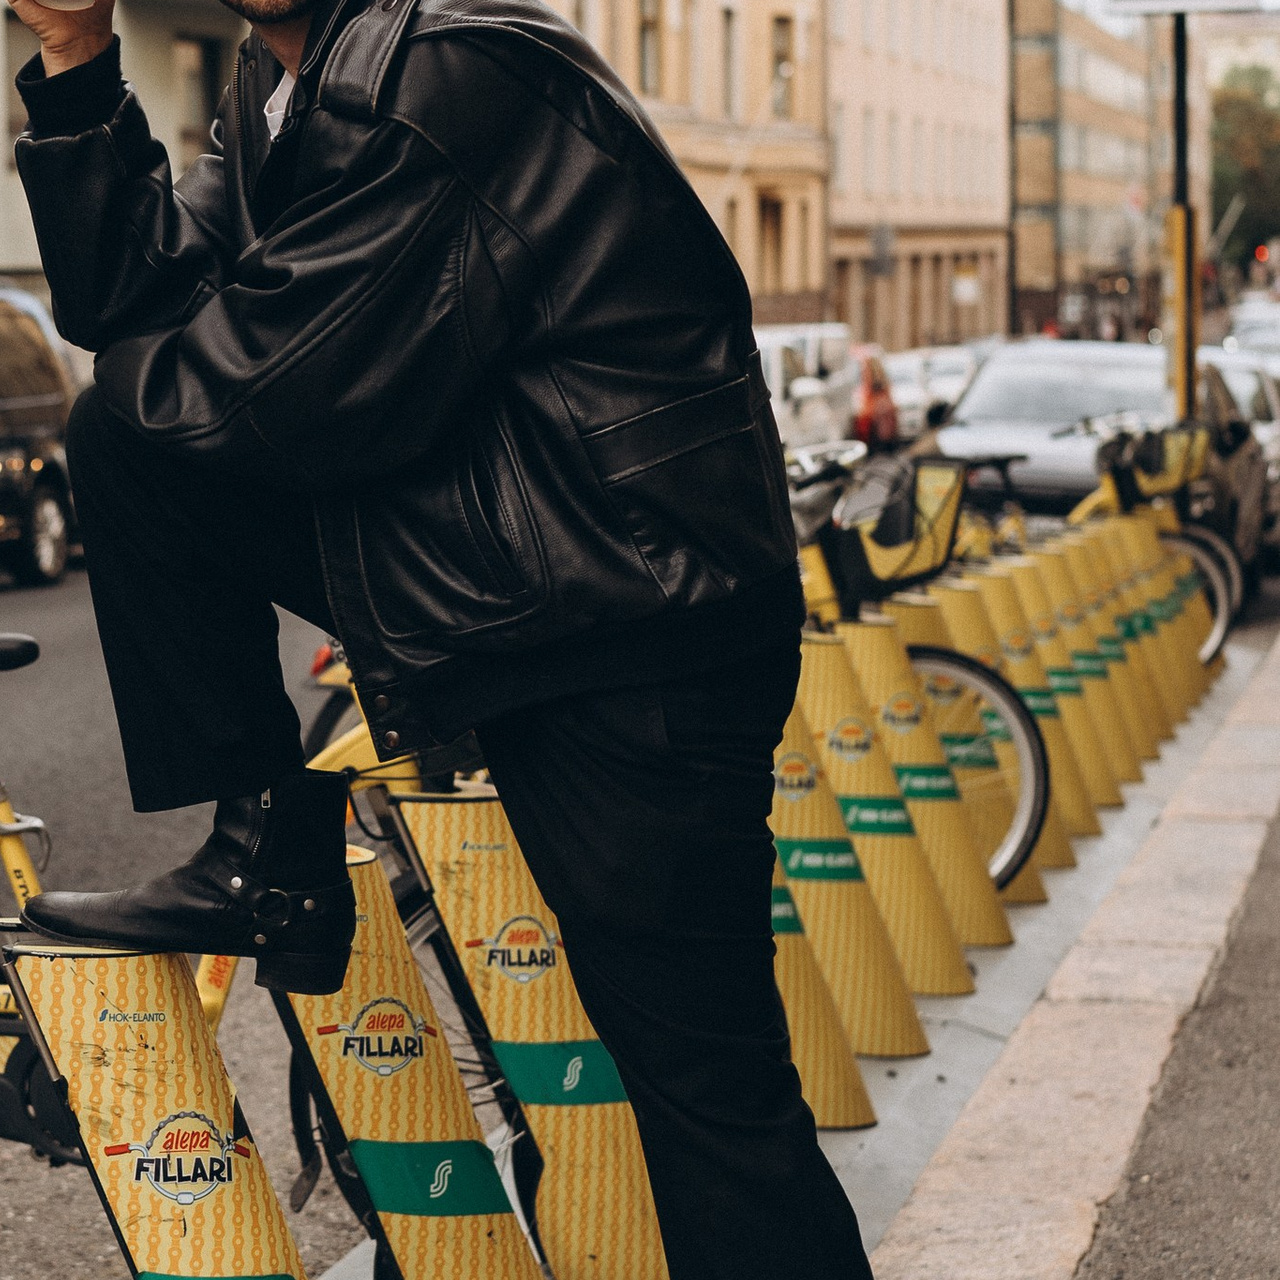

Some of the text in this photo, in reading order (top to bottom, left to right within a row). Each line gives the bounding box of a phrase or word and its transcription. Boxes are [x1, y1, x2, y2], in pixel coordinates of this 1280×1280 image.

[487, 948, 557, 968] FILLARI
[208, 955, 232, 989] alep
[108, 1012, 166, 1022] HOK-ELANTO
[365, 1011, 405, 1032] alepa
[342, 1035, 423, 1058] FILLARI
[162, 1128, 211, 1153] alepa
[134, 1156, 233, 1183] FILLARI
